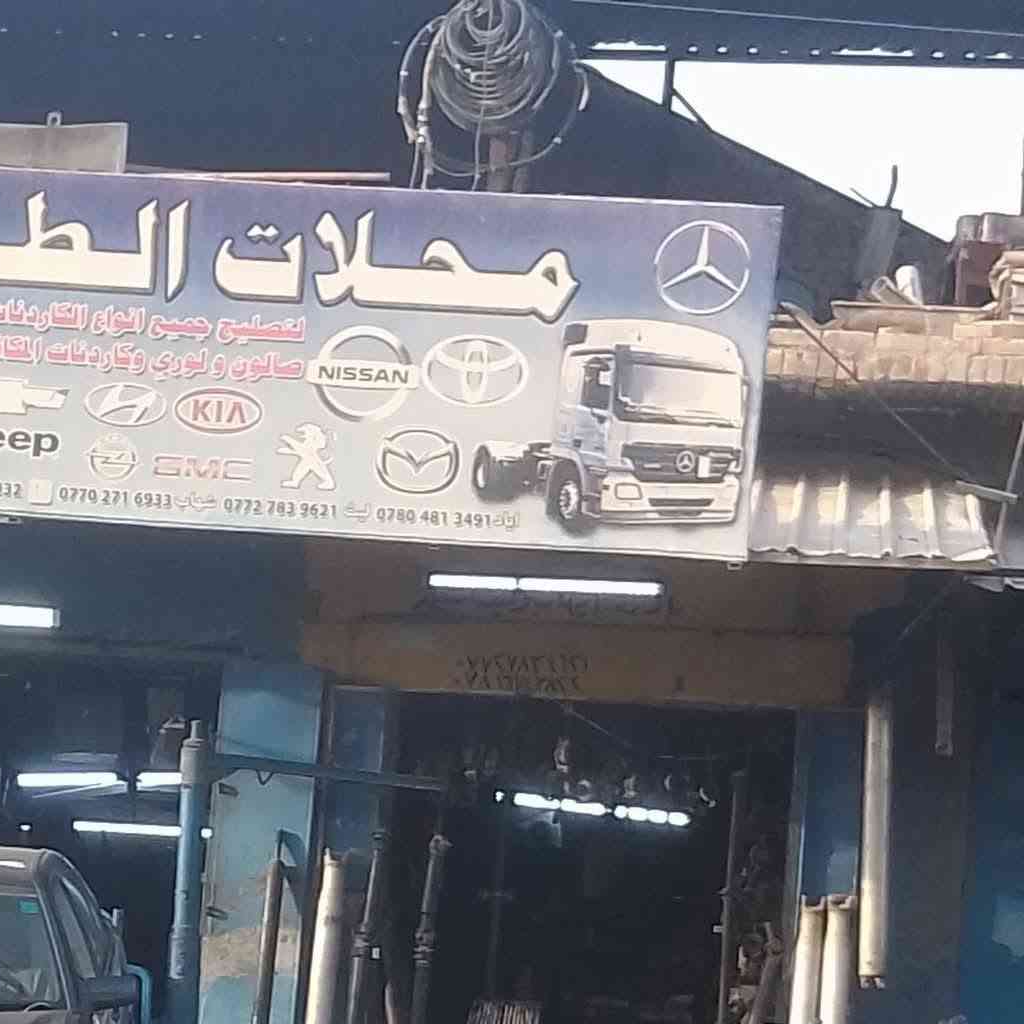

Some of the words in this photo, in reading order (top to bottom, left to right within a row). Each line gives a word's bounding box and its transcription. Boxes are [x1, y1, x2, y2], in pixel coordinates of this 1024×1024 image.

[212, 209, 581, 324] محلات
[89, 306, 146, 335] انواع
[147, 314, 213, 342] جميع
[215, 315, 306, 343] لتصليح
[148, 347, 207, 381] لوري
[209, 353, 226, 378] و
[228, 353, 305, 382] صالون
[317, 364, 410, 385] NISSAN
[189, 398, 247, 425] KIA
[58, 486, 98, 505] 0770
[100, 489, 129, 507] 271
[133, 491, 172, 510] 6933
[223, 497, 263, 516] 0772
[267, 499, 295, 517] 783
[299, 502, 337, 520] 9621
[376, 506, 416, 524] 0780
[419, 508, 449, 526] 481
[453, 511, 491, 529] 3491
